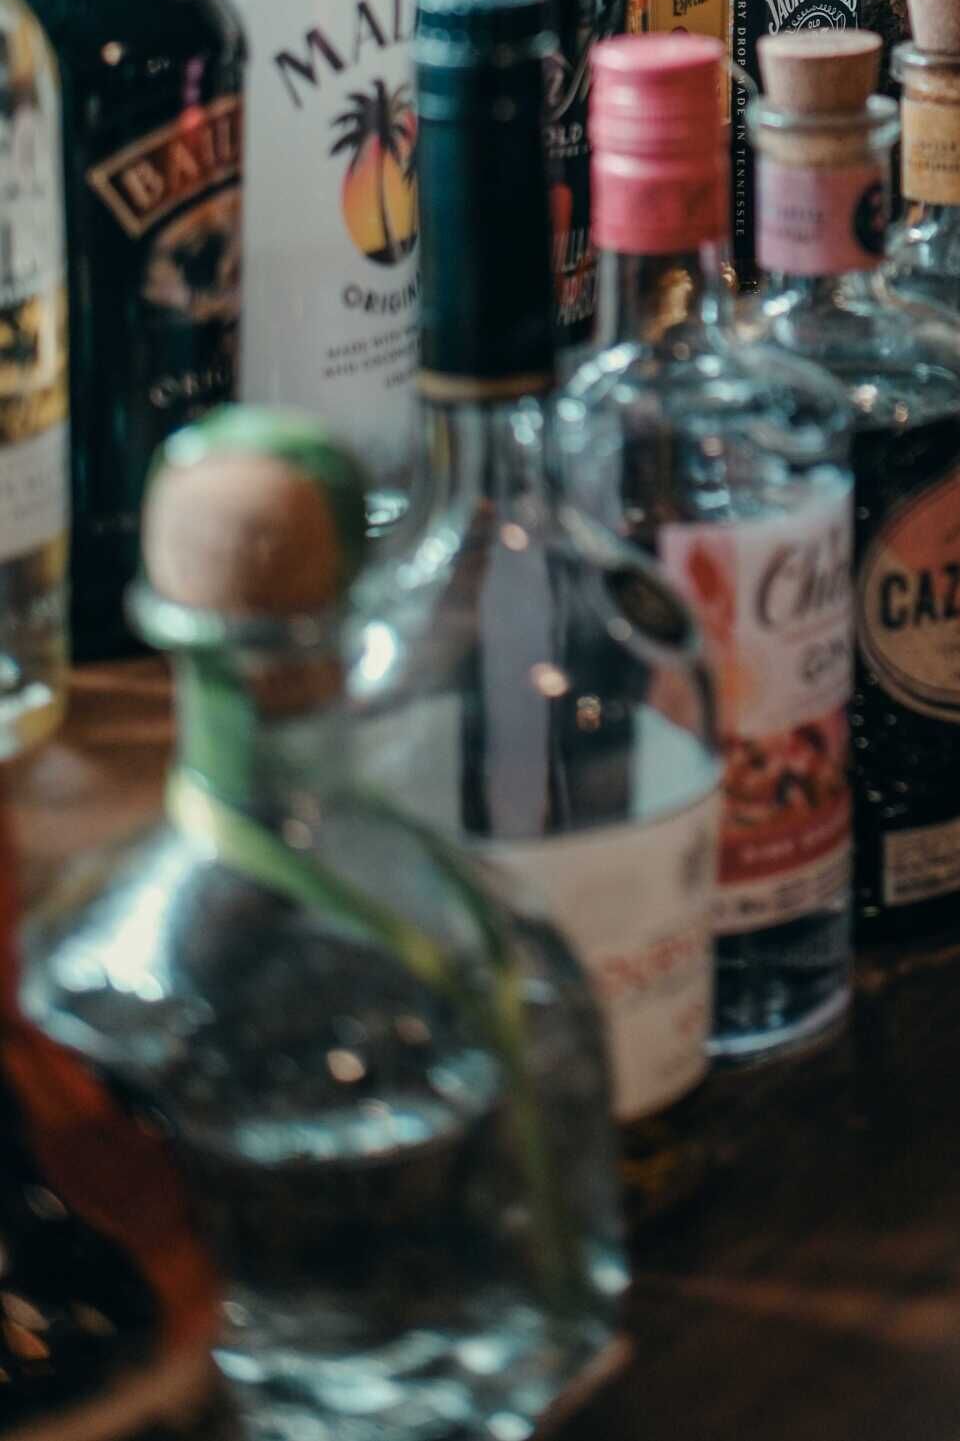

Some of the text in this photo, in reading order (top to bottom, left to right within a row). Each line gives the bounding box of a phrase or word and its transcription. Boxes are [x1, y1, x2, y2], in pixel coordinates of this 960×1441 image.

[807, 18, 820, 29] OLD
[736, 27, 747, 67] DROP
[735, 125, 745, 141] IN
[735, 146, 745, 238] TENNESSEE
